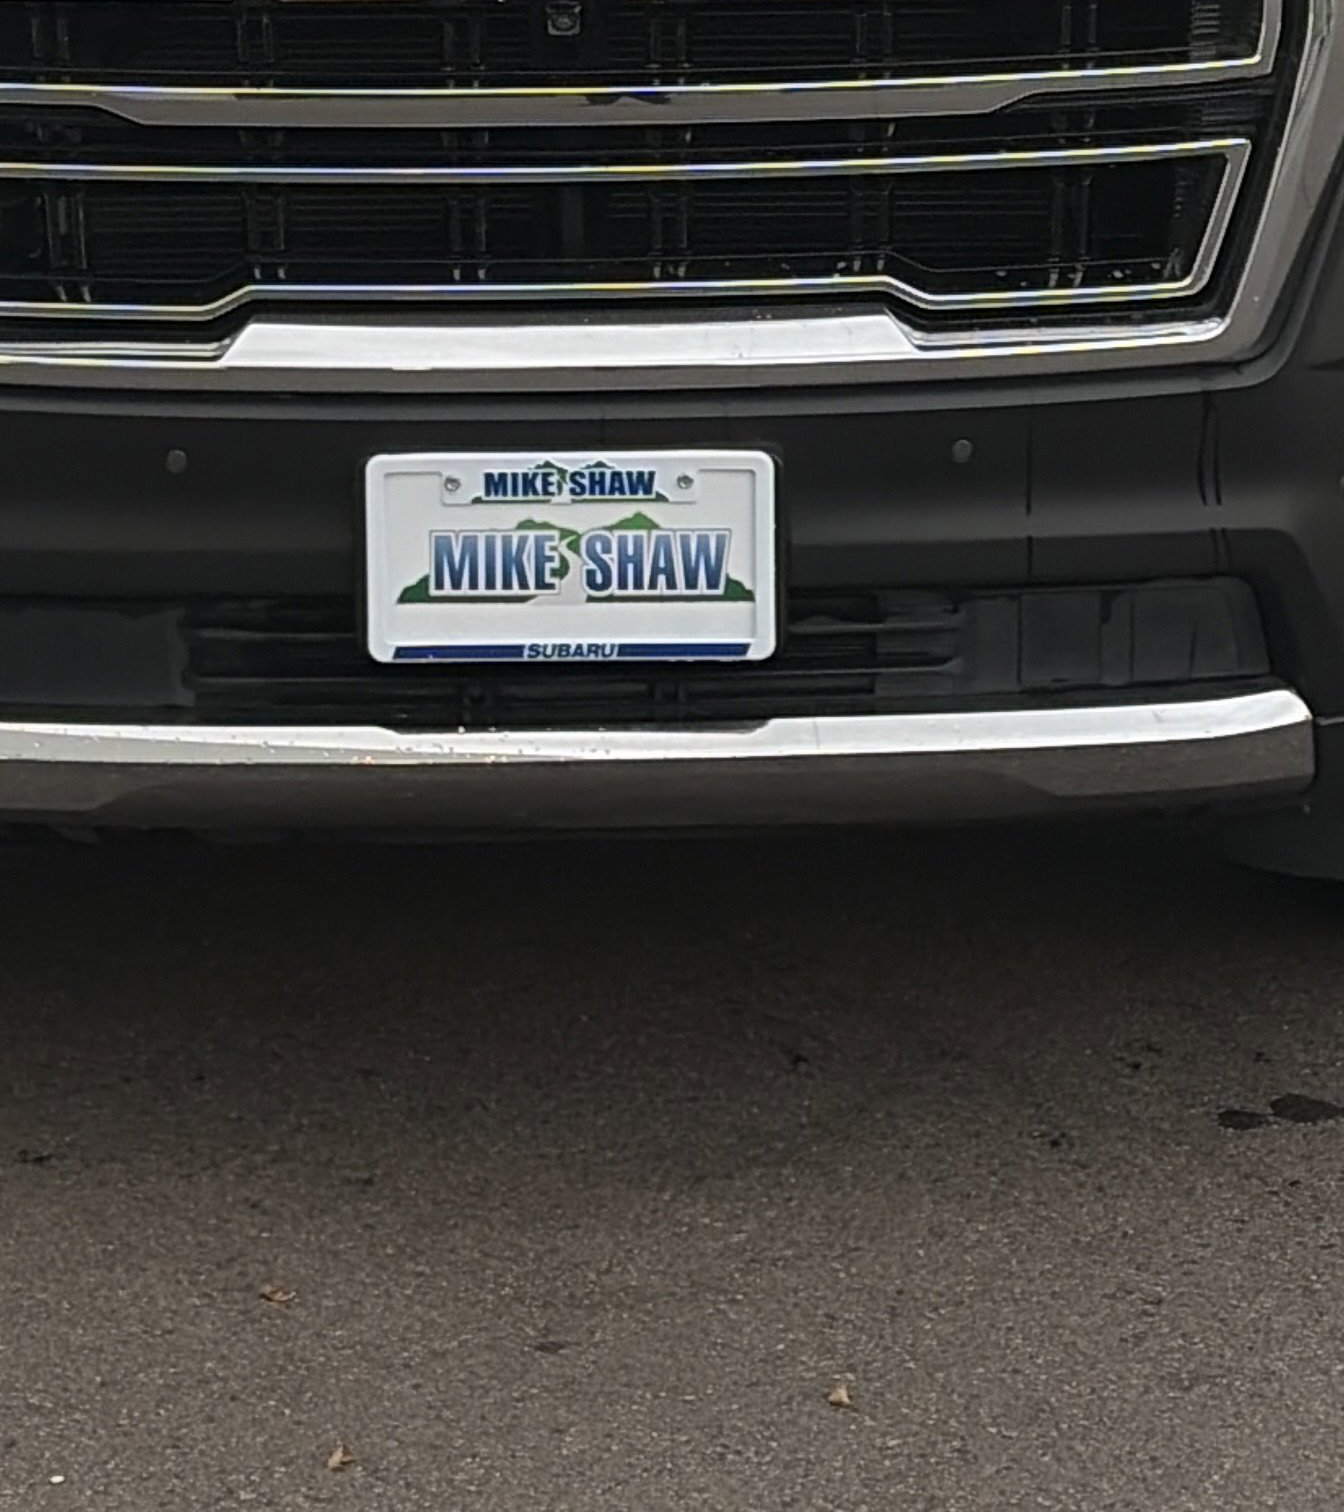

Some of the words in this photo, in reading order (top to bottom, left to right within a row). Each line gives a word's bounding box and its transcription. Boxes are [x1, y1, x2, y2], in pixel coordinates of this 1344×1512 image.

[483, 471, 555, 497] MIKE
[569, 470, 656, 497] SHAW
[432, 532, 558, 592] MIKE
[583, 531, 730, 593] SHAW
[526, 643, 619, 659] SUBARU
